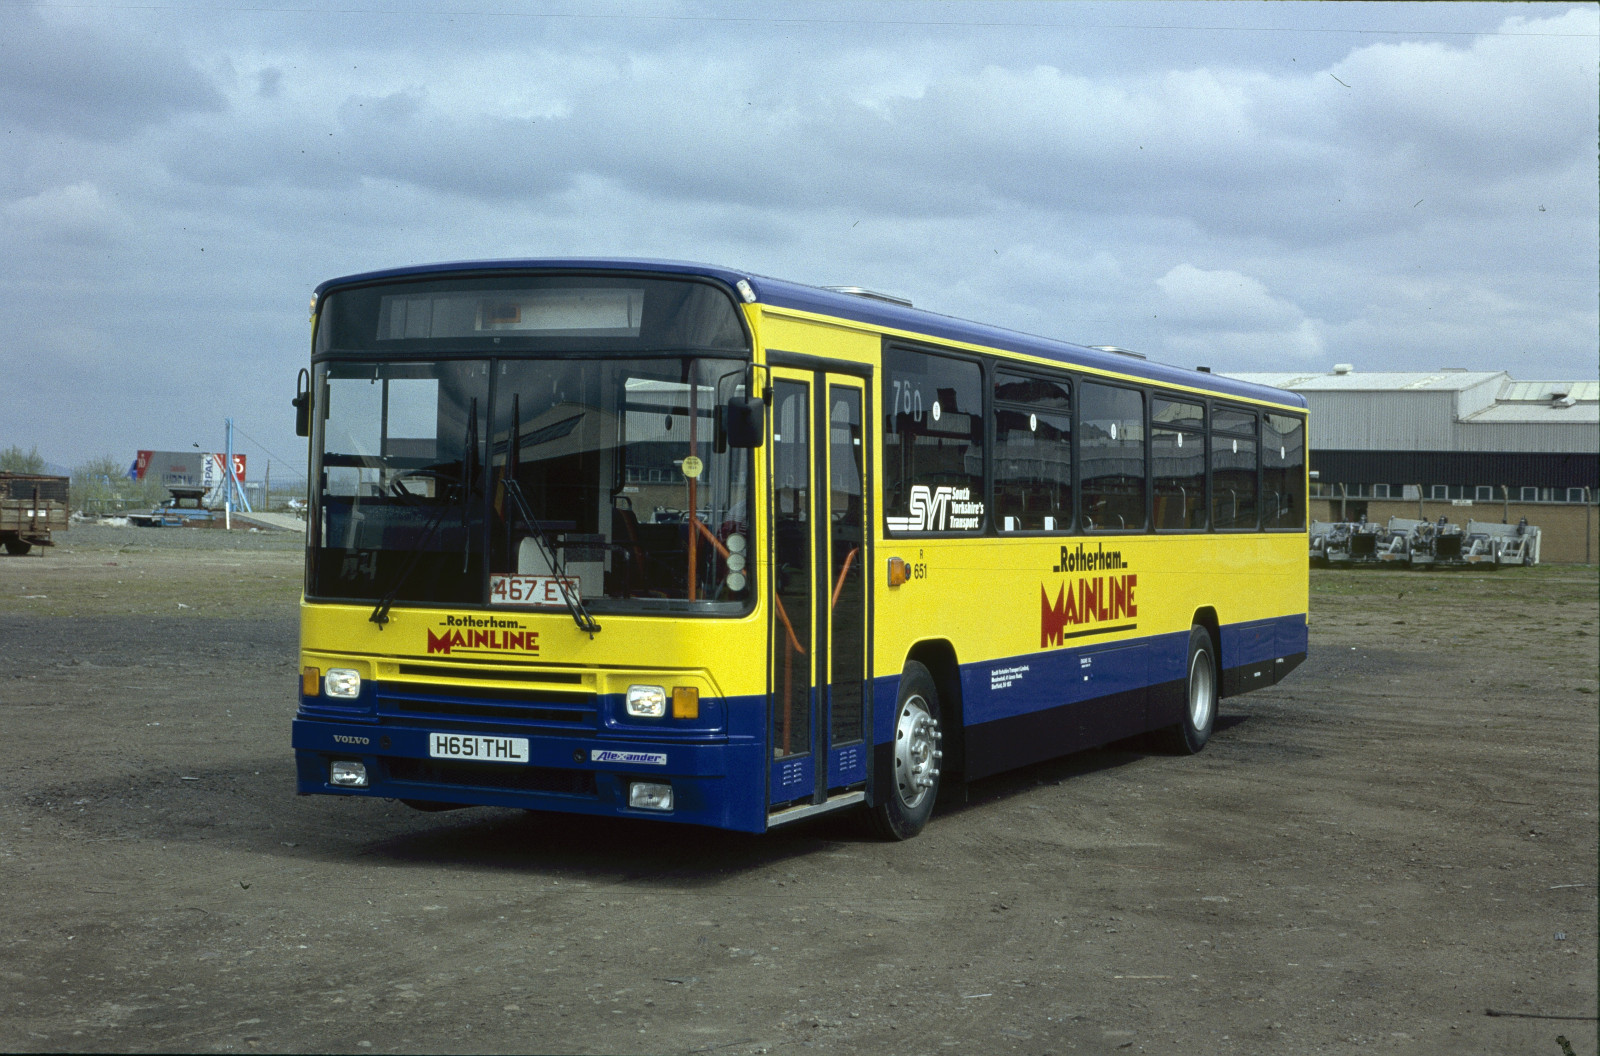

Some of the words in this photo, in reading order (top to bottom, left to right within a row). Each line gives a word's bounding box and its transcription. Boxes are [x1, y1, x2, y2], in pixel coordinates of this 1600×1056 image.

[951, 487, 970, 501] South
[887, 485, 952, 531] SYT
[951, 501, 984, 514] Yorkshire's
[950, 515, 979, 530] Transport
[1060, 542, 1122, 572] Rotherham
[913, 563, 928, 579] 651
[494, 579, 541, 601] 467
[1041, 574, 1138, 649] MAINLINE
[446, 615, 519, 629] Rotherham
[427, 627, 540, 655] MAINLINE
[333, 734, 370, 745] VOLVO
[436, 735, 479, 756] H651
[483, 738, 521, 759] THL
[596, 751, 662, 762] Alexander
